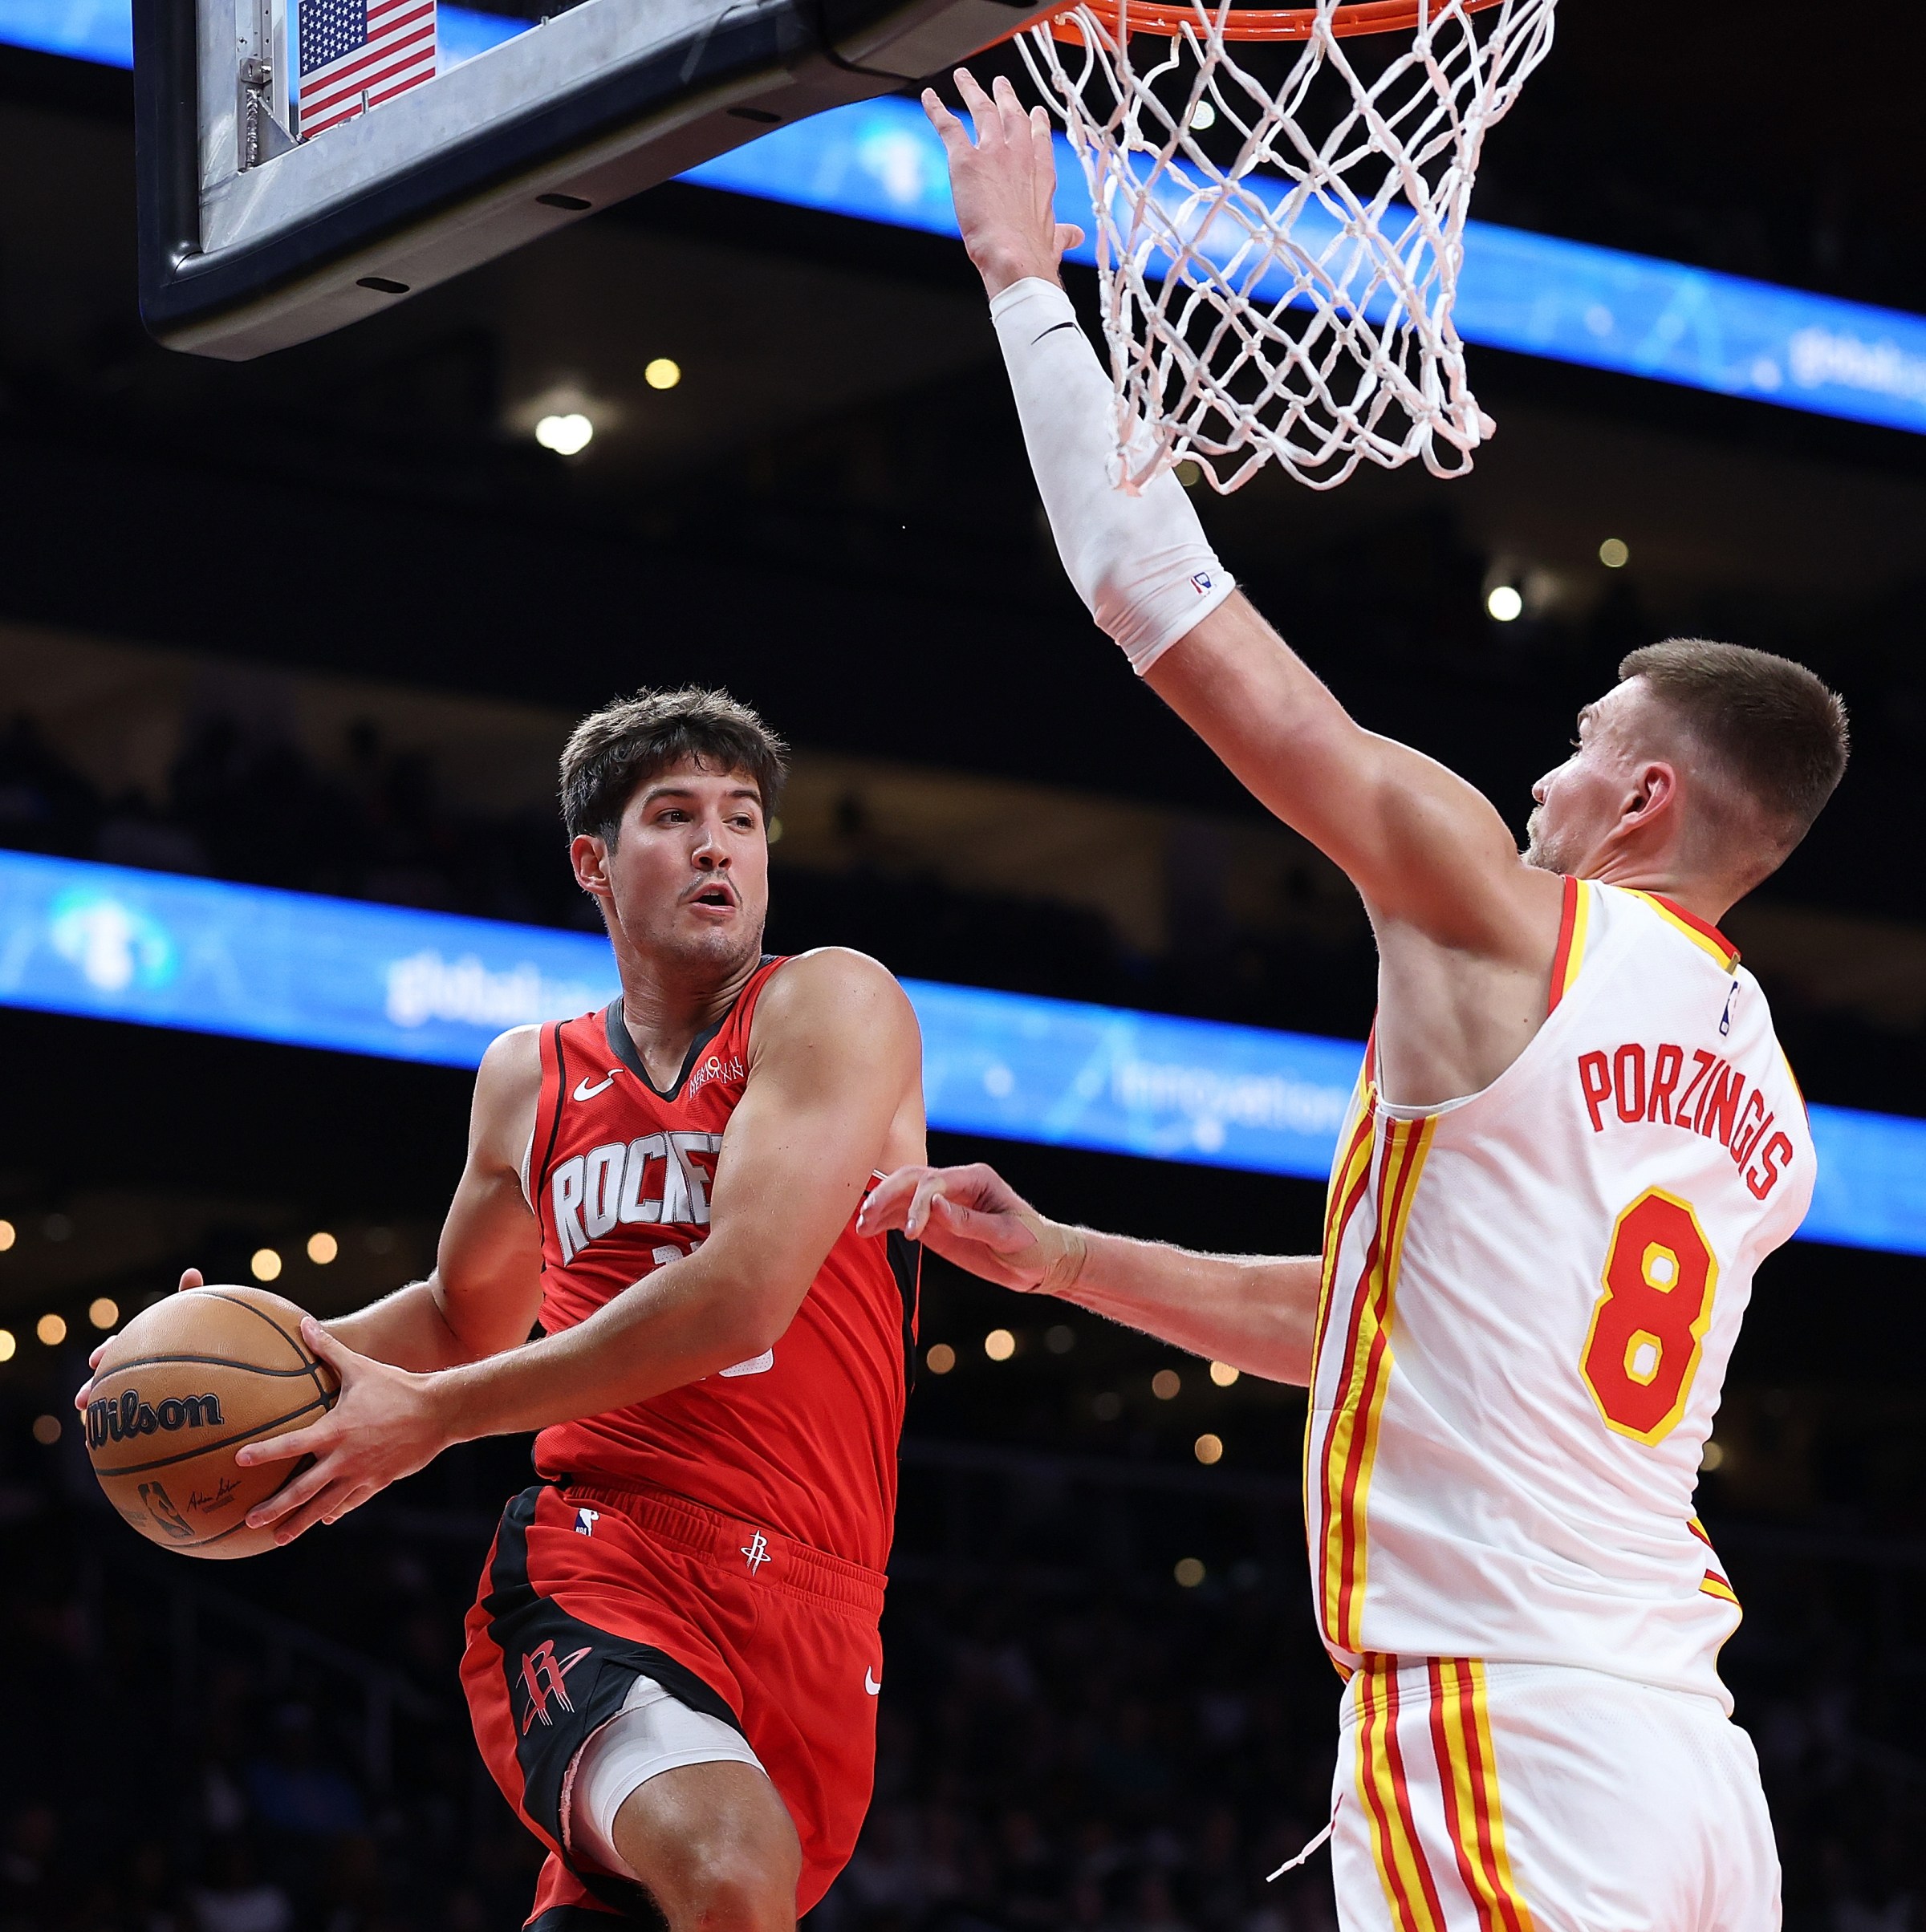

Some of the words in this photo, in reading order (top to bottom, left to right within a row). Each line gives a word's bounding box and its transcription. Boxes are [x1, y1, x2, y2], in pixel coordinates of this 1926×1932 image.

[1579, 1044, 1793, 1200] PORZINGIS
[1579, 1185, 1719, 1448] 8
[86, 1388, 225, 1451] Wilson
